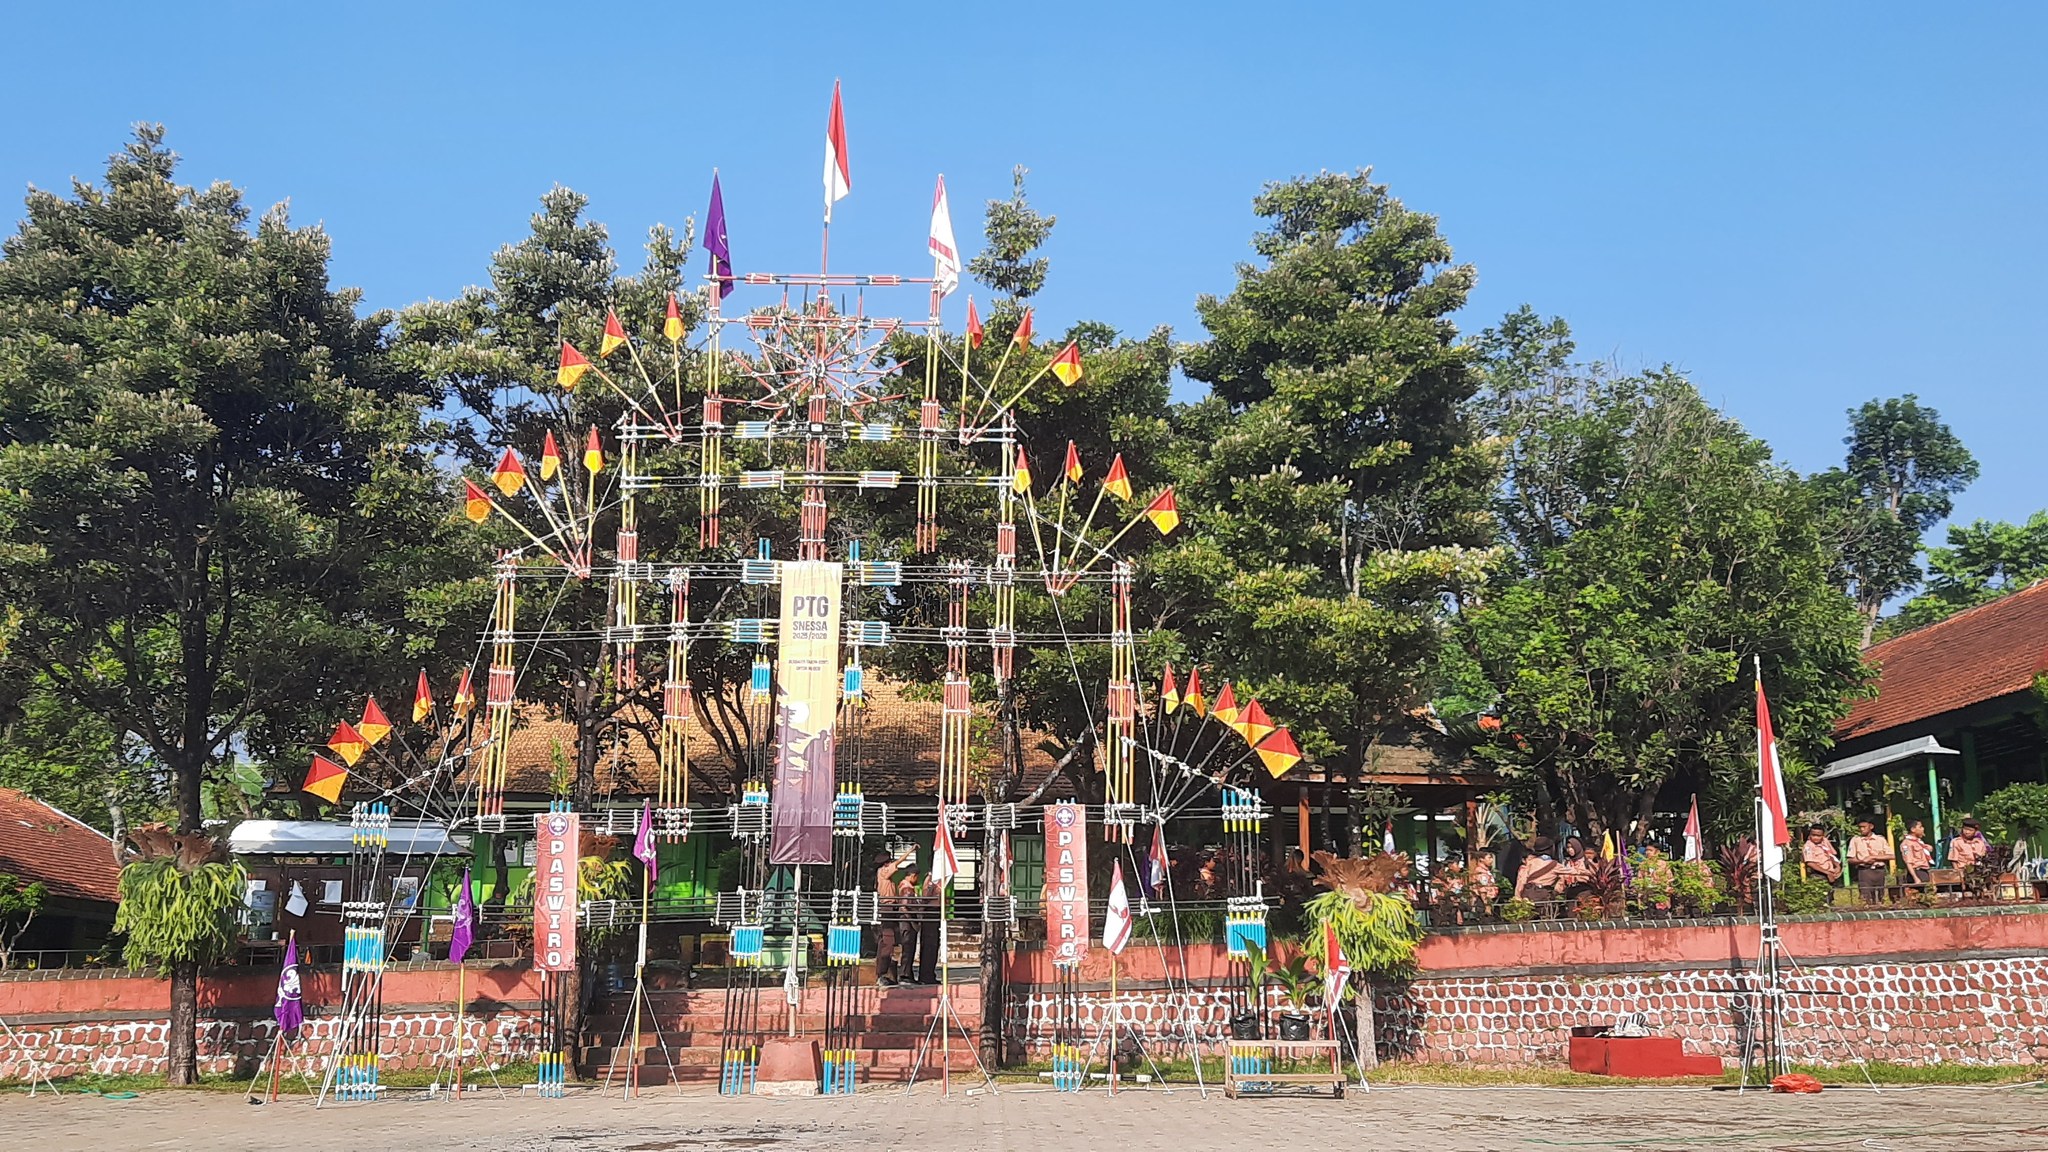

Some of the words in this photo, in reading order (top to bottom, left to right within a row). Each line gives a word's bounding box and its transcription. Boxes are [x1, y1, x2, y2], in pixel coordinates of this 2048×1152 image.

[793, 596, 829, 617] PTG
[793, 621, 828, 631] SNESSA
[546, 839, 565, 967] PASWIRO
[1058, 831, 1076, 957] PASWIRO
